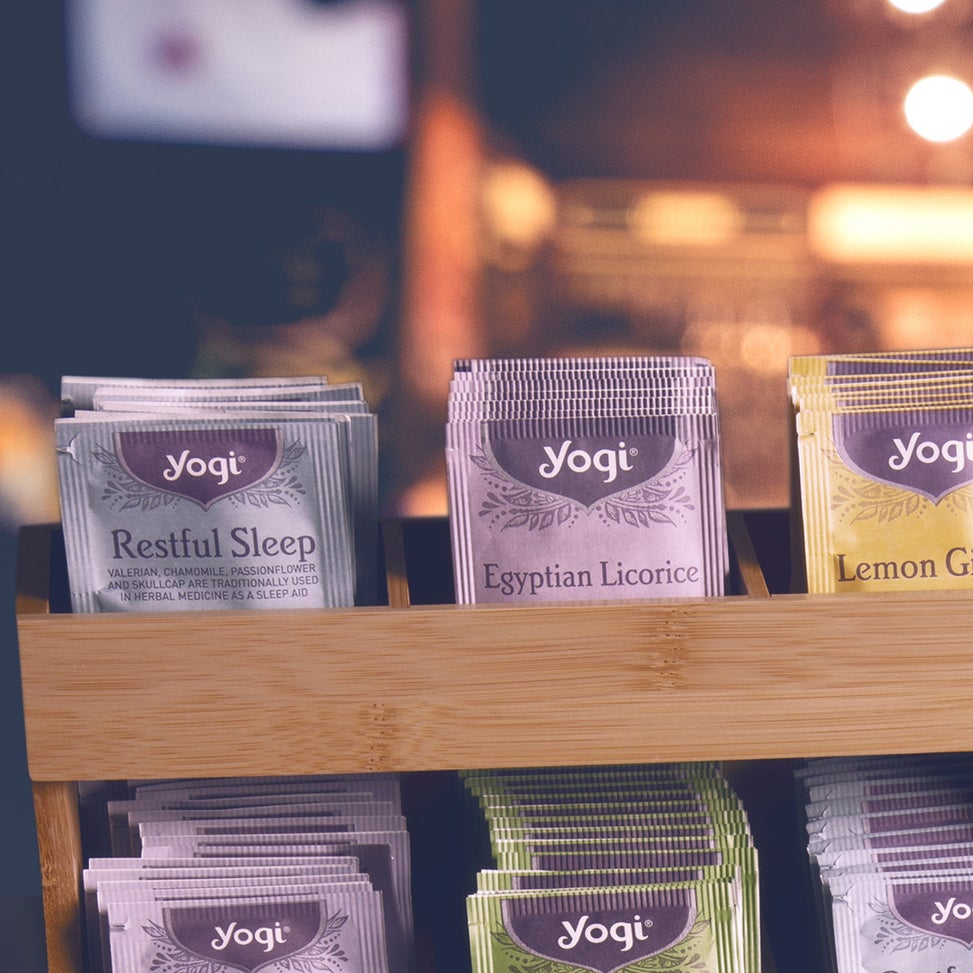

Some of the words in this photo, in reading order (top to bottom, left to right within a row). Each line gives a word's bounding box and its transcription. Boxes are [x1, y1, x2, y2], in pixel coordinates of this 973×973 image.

[111, 528, 222, 559] Restful
[231, 527, 316, 562] Sleep
[107, 568, 162, 579] VALERIAN,
[164, 566, 229, 578] CHAMOMILE,
[231, 563, 316, 576] PASSIONFLOWER
[483, 562, 593, 596] Egyptian
[600, 560, 699, 587] Licorice
[836, 553, 937, 582] Lemon
[107, 580, 129, 590] AND
[132, 579, 185, 589] SKULLCAP
[189, 579, 208, 588] ARE
[211, 576, 289, 588] TRADITIONALLY
[292, 575, 318, 586] USED
[120, 592, 132, 601] IN
[135, 591, 175, 601] HERBAL
[178, 590, 228, 600] MEDICINE
[231, 591, 245, 600] AS
[247, 590, 255, 600] A
[256, 589, 288, 599] SLEEP
[291, 587, 309, 598] AID
